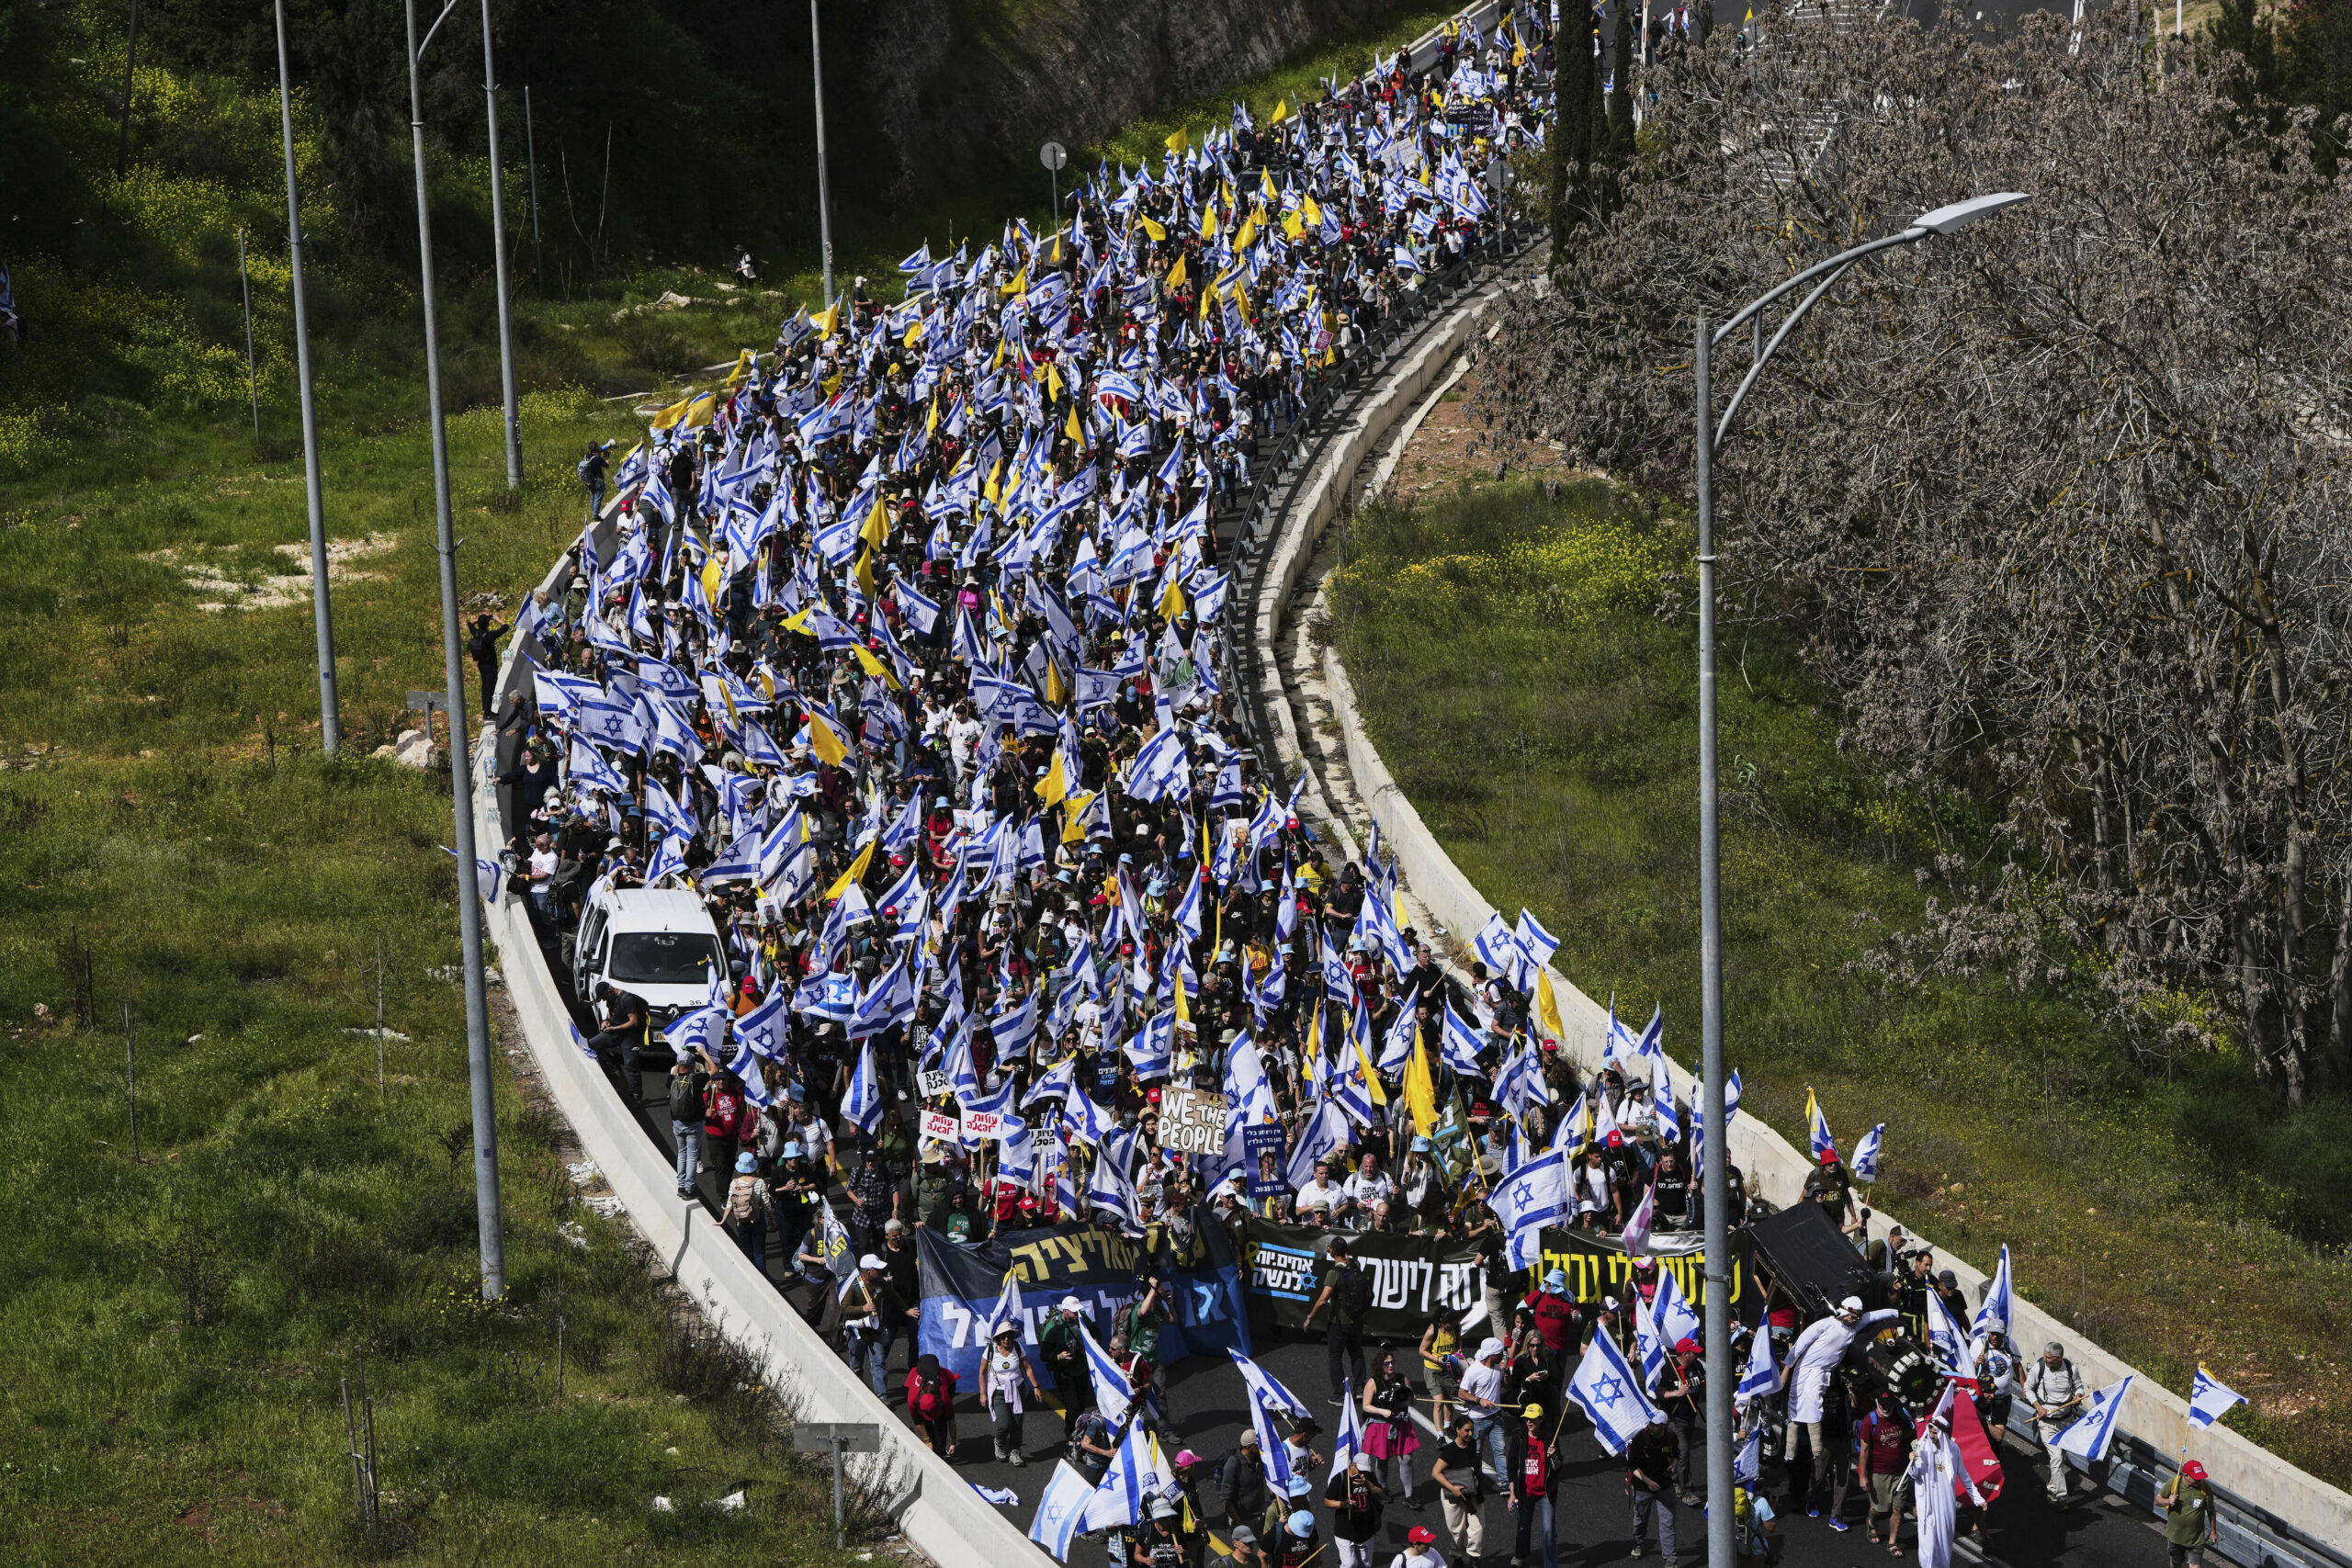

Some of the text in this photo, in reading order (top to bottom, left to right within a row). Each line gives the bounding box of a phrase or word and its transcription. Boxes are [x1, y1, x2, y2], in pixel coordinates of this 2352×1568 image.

[1161, 1089, 1227, 1129] WE THE
[1158, 1116, 1226, 1156] PEOPLE
[1362, 1186, 1376, 1194] אתה
[1251, 1266, 1303, 1292] לנשק
